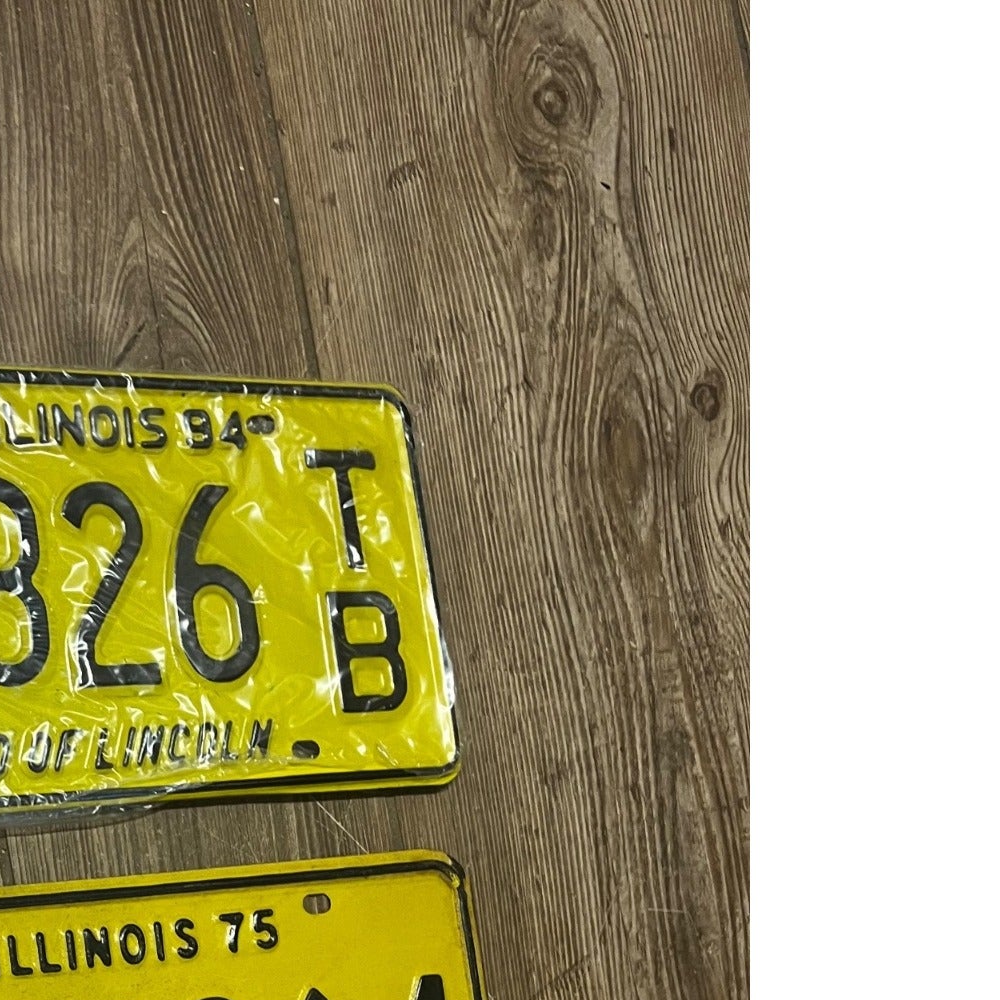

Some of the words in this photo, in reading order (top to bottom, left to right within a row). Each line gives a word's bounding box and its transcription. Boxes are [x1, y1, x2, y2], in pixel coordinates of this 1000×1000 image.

[24, 729, 84, 774] OF
[95, 719, 273, 770] LINCOLN
[221, 911, 280, 955] 75
